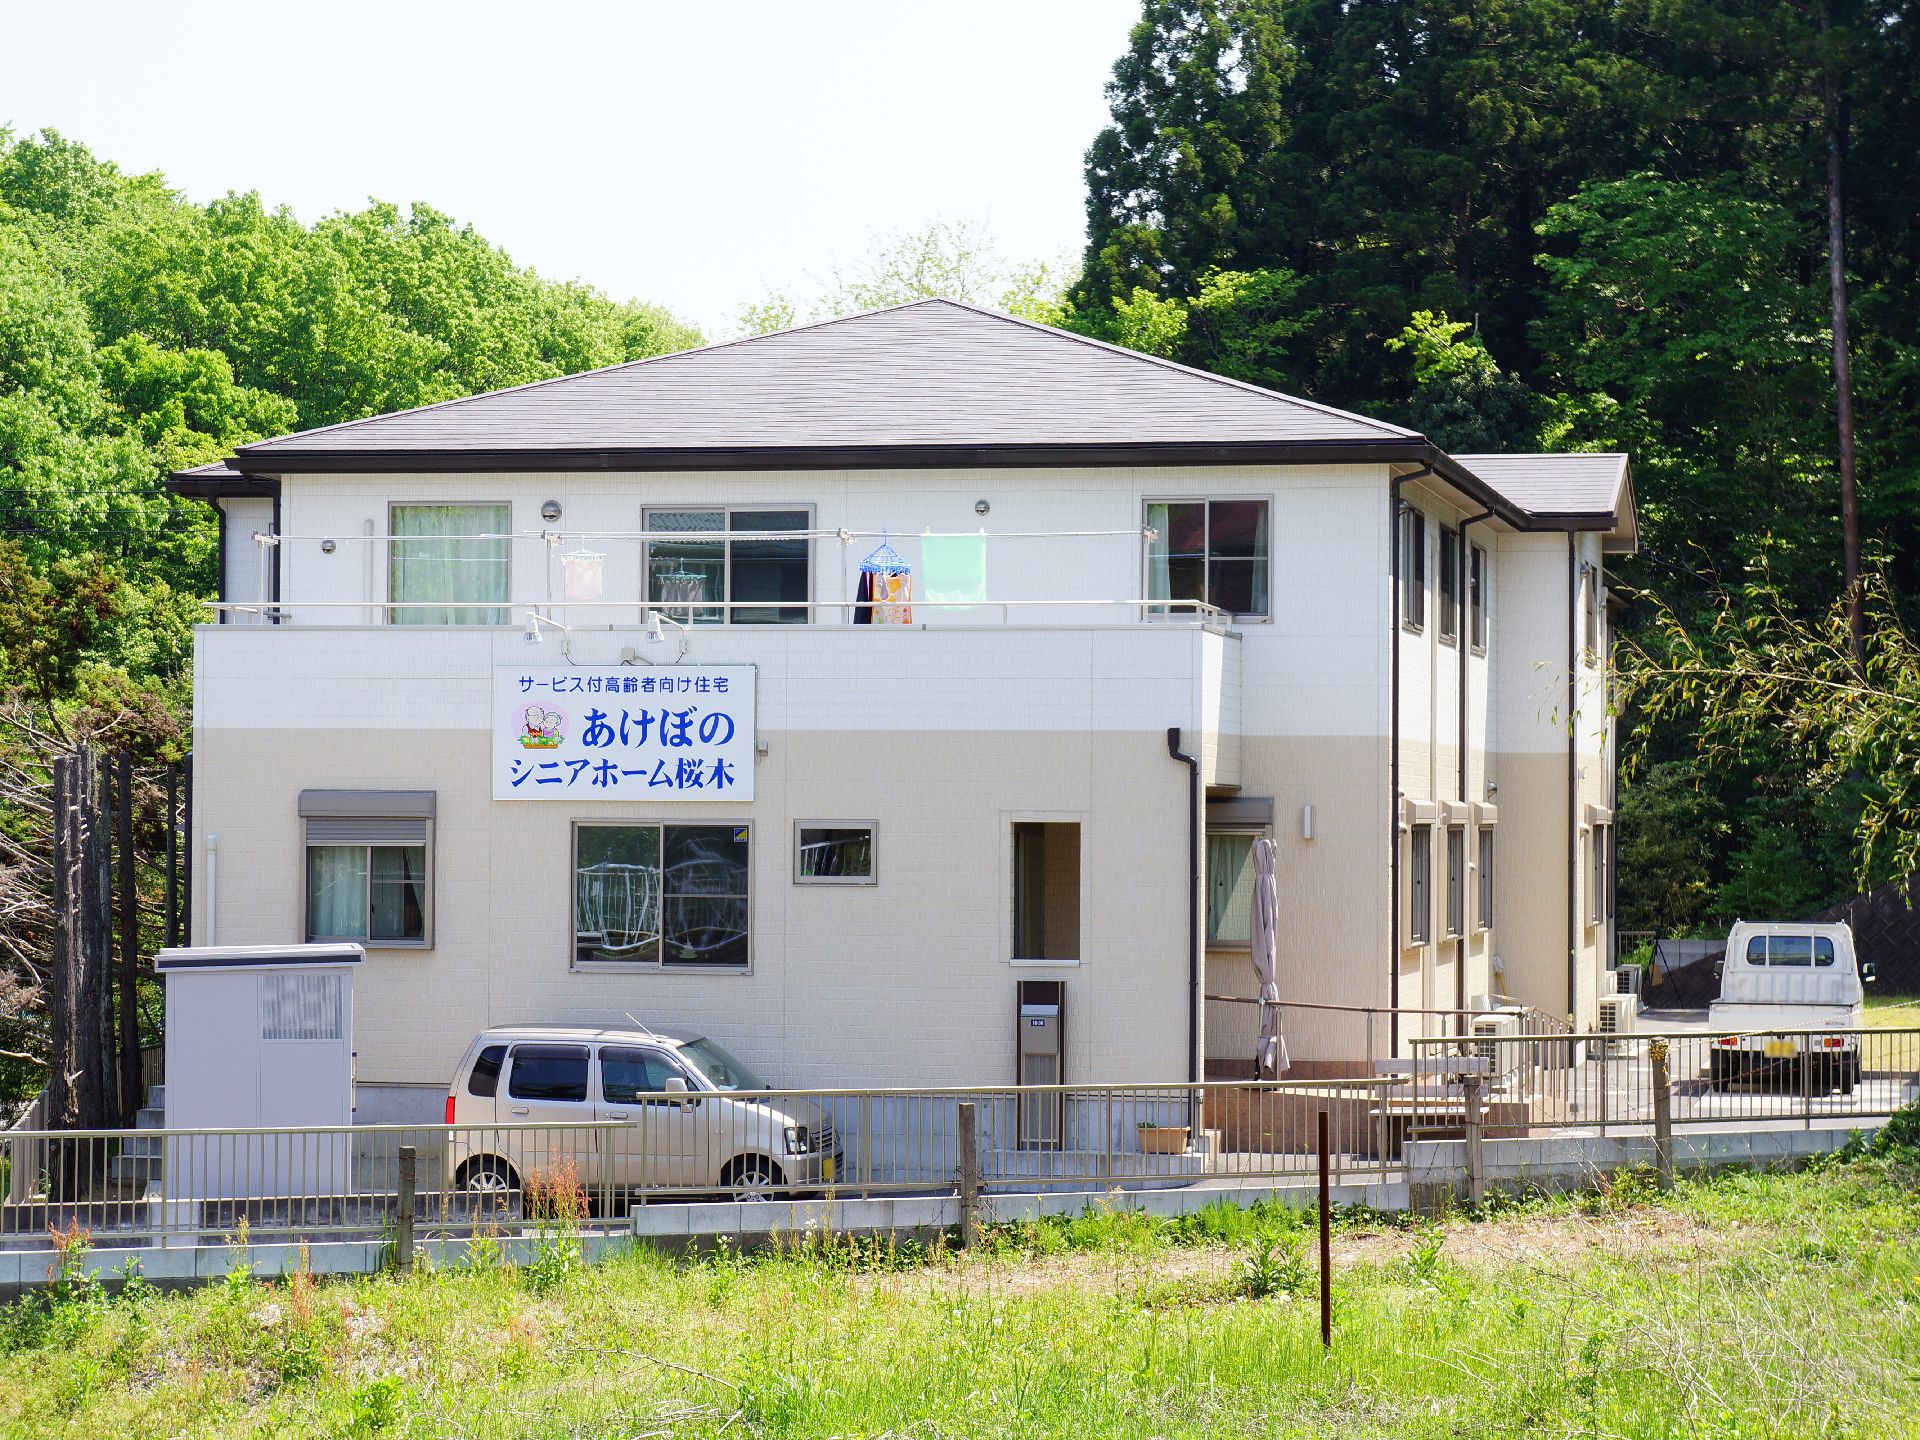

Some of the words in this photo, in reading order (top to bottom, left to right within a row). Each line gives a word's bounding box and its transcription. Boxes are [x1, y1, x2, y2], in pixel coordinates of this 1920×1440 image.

[519, 676, 729, 693] サービス付高齢者向け住宅
[582, 705, 735, 748] あけぼの
[509, 758, 735, 789] シニアホーム桜木
